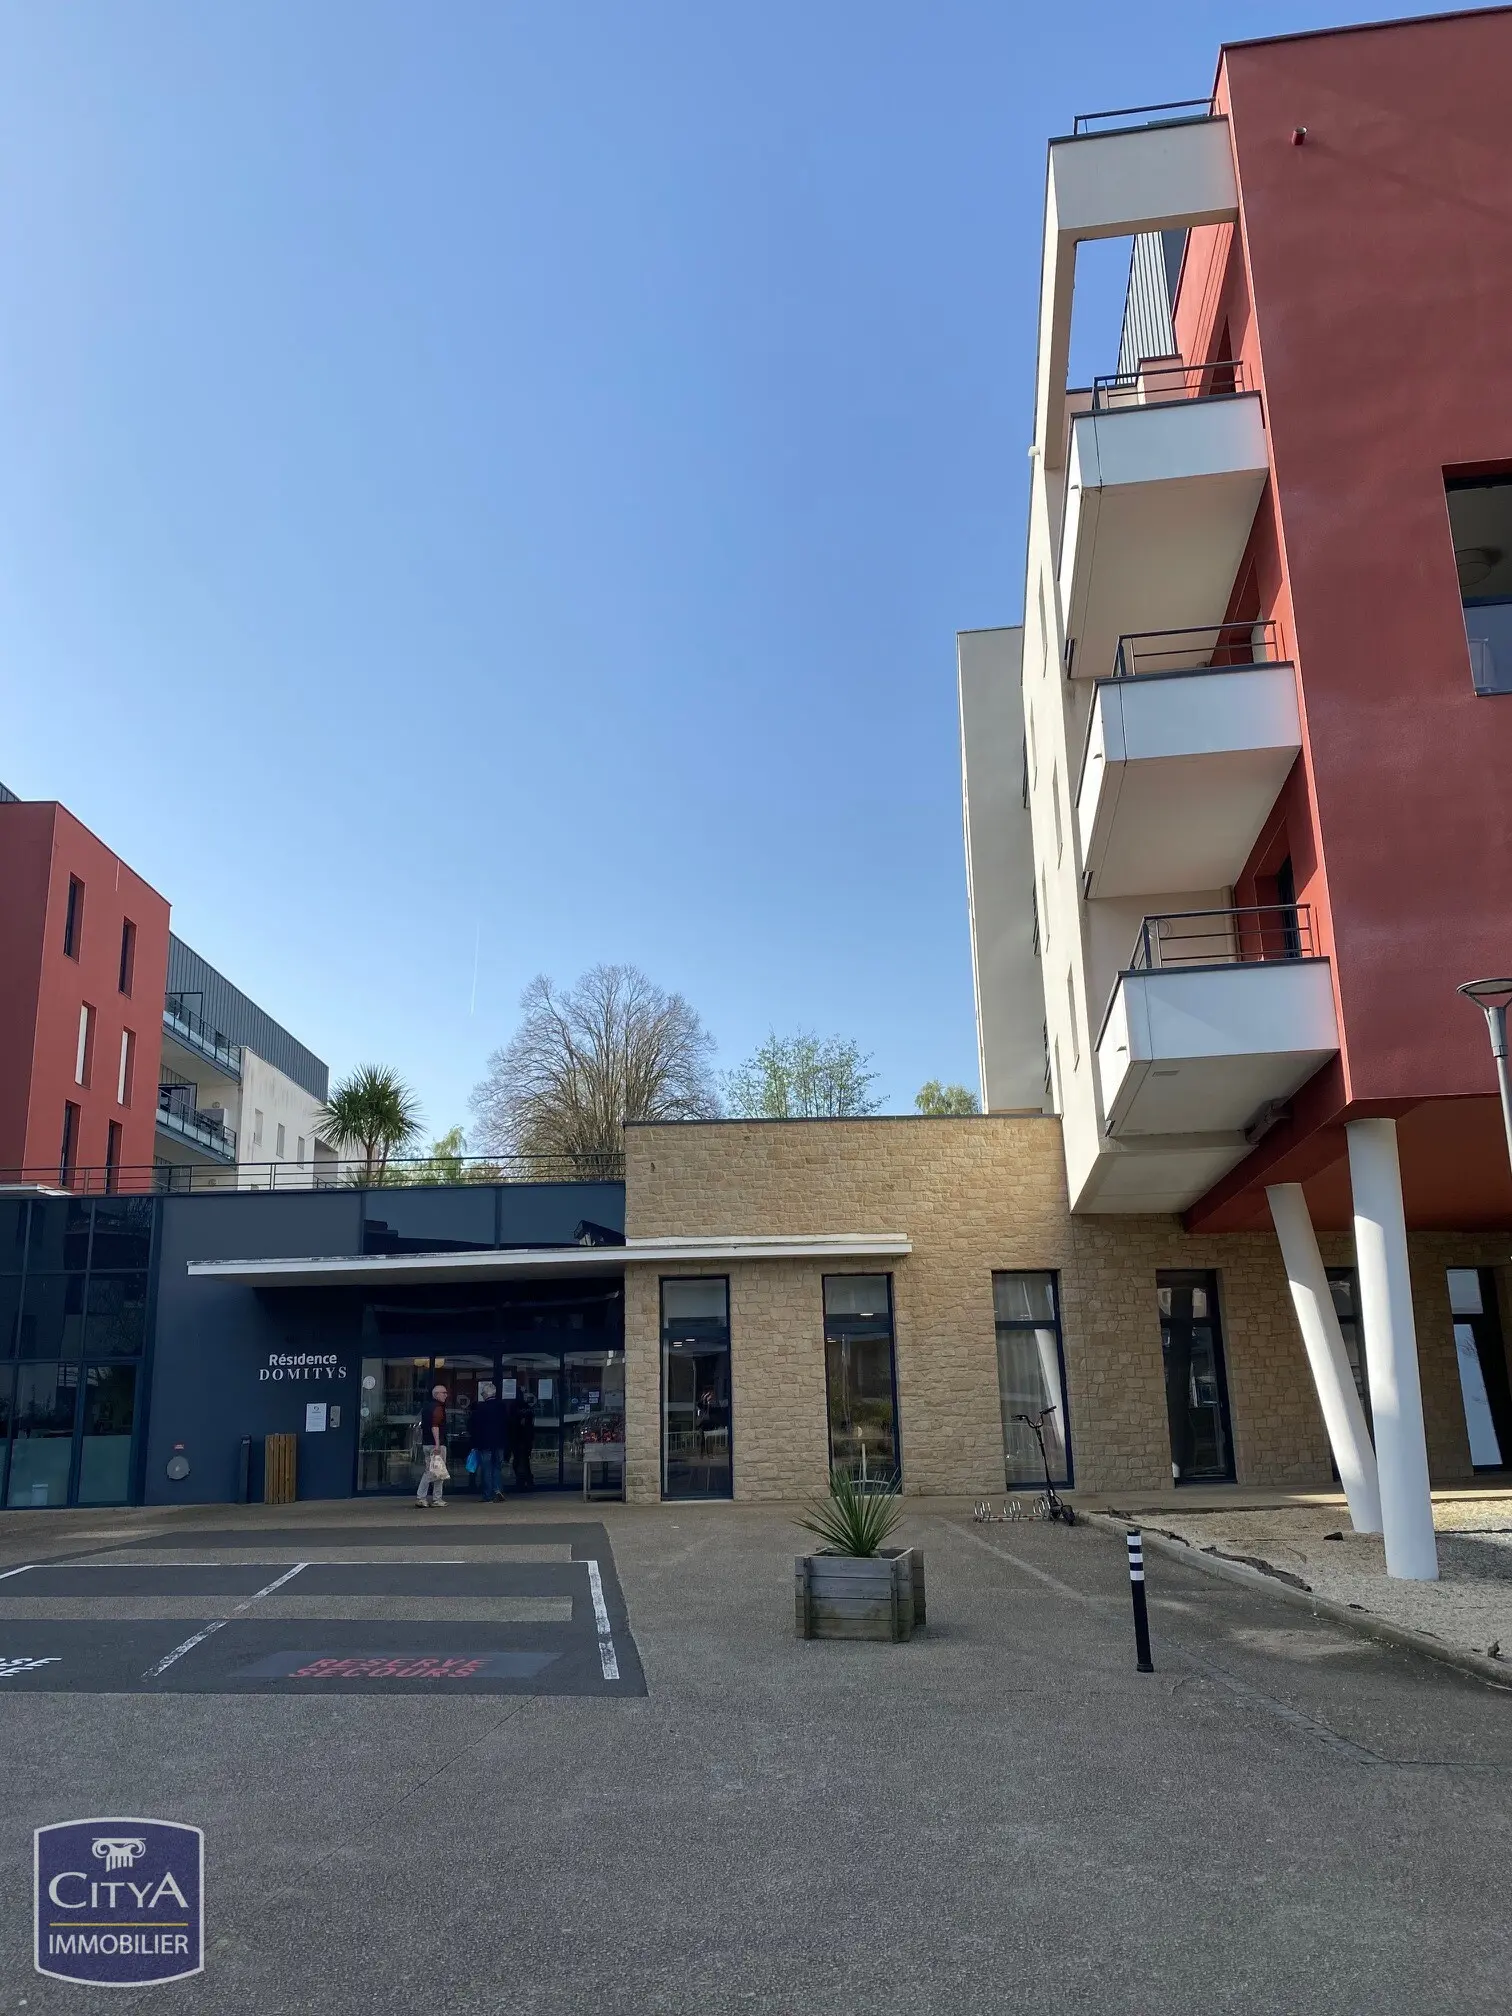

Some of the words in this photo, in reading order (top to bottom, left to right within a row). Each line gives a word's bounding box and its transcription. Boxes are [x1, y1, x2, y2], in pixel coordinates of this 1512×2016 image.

[269, 1353, 338, 1366] Résidence
[259, 1366, 348, 1381] DOMITYS
[288, 1667, 476, 1678] SECOURS
